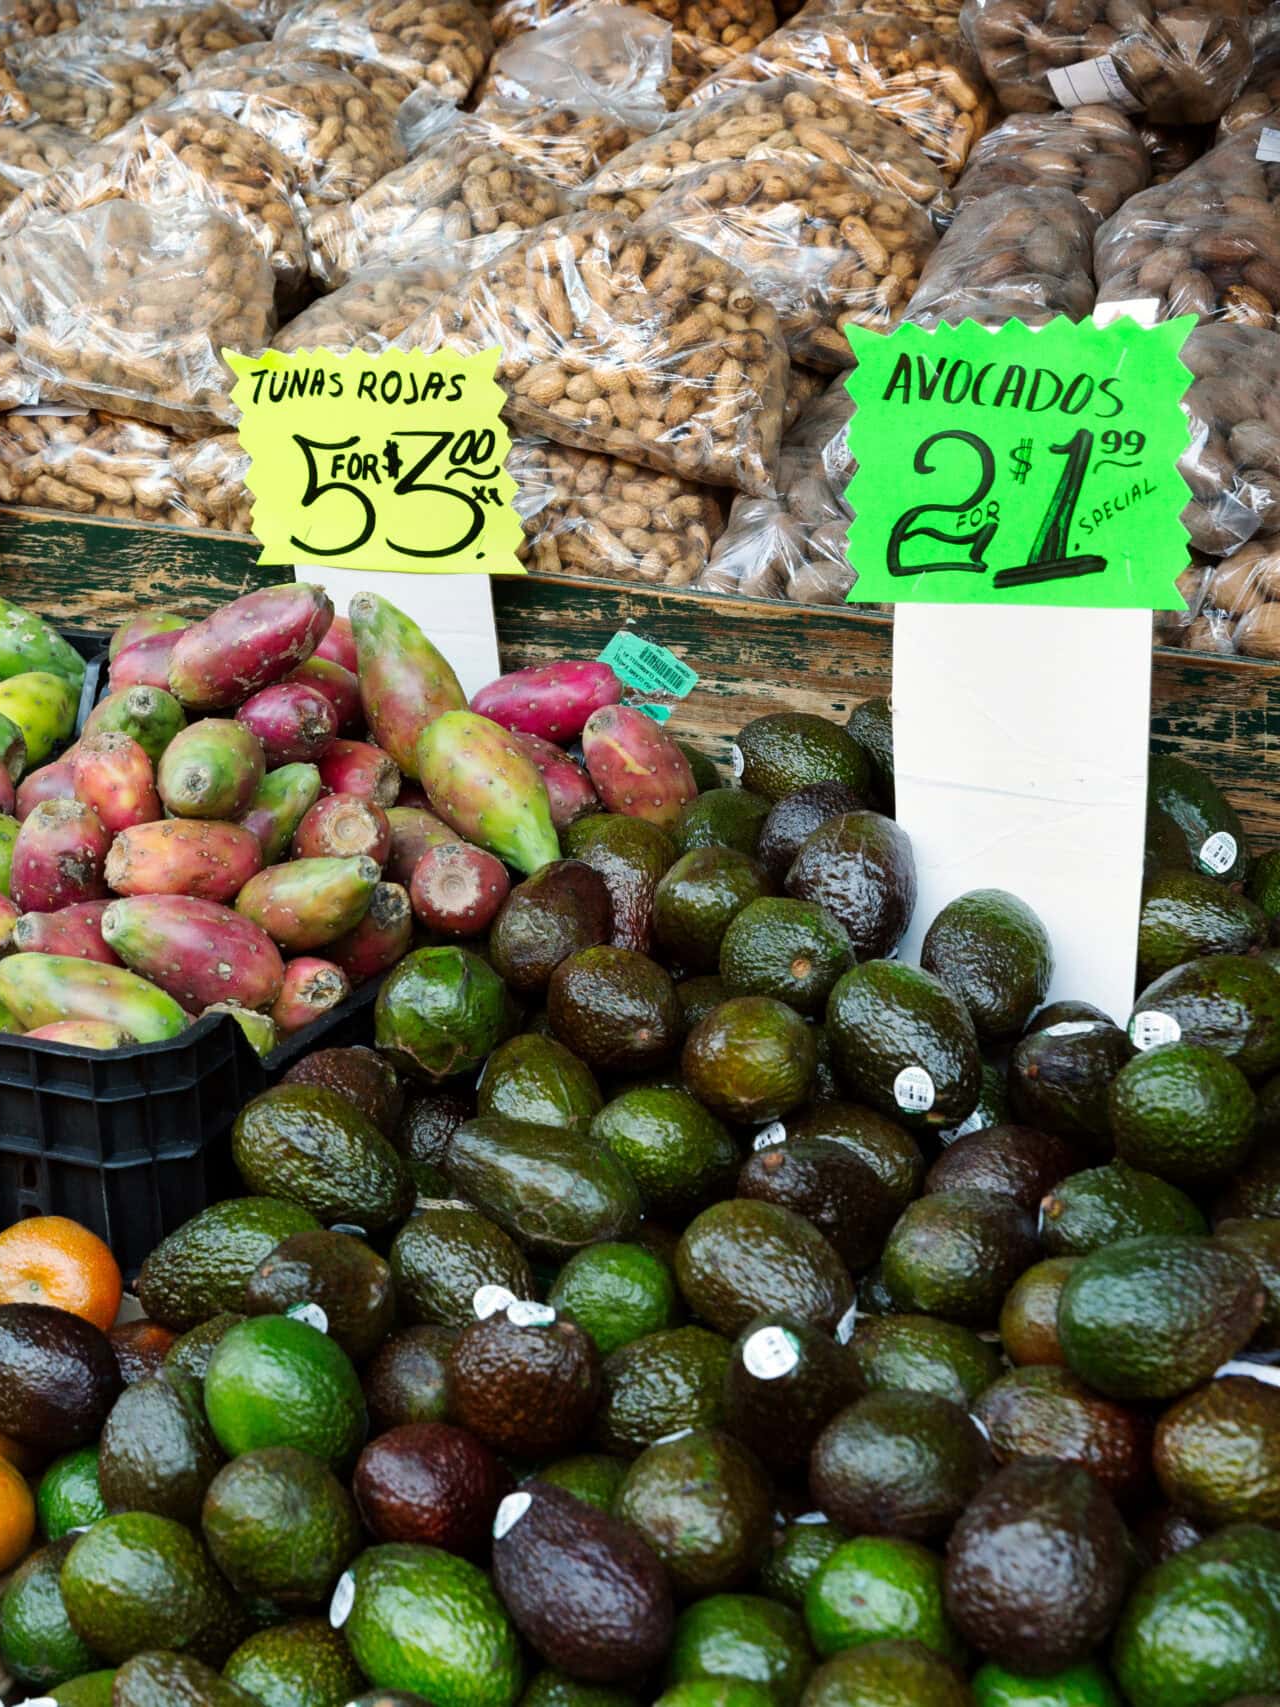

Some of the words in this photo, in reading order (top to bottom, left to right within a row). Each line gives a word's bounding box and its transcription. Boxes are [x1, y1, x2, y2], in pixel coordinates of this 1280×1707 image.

[251, 368, 344, 404] TUNAS
[357, 370, 466, 405] ROJAS
[883, 353, 1124, 418] AVOCADOS
[290, 434, 376, 556] 5
[331, 453, 382, 484] FOR
[887, 430, 999, 577] 2
[956, 501, 1000, 532] FOR
[1079, 478, 1158, 535] SPECIAL
